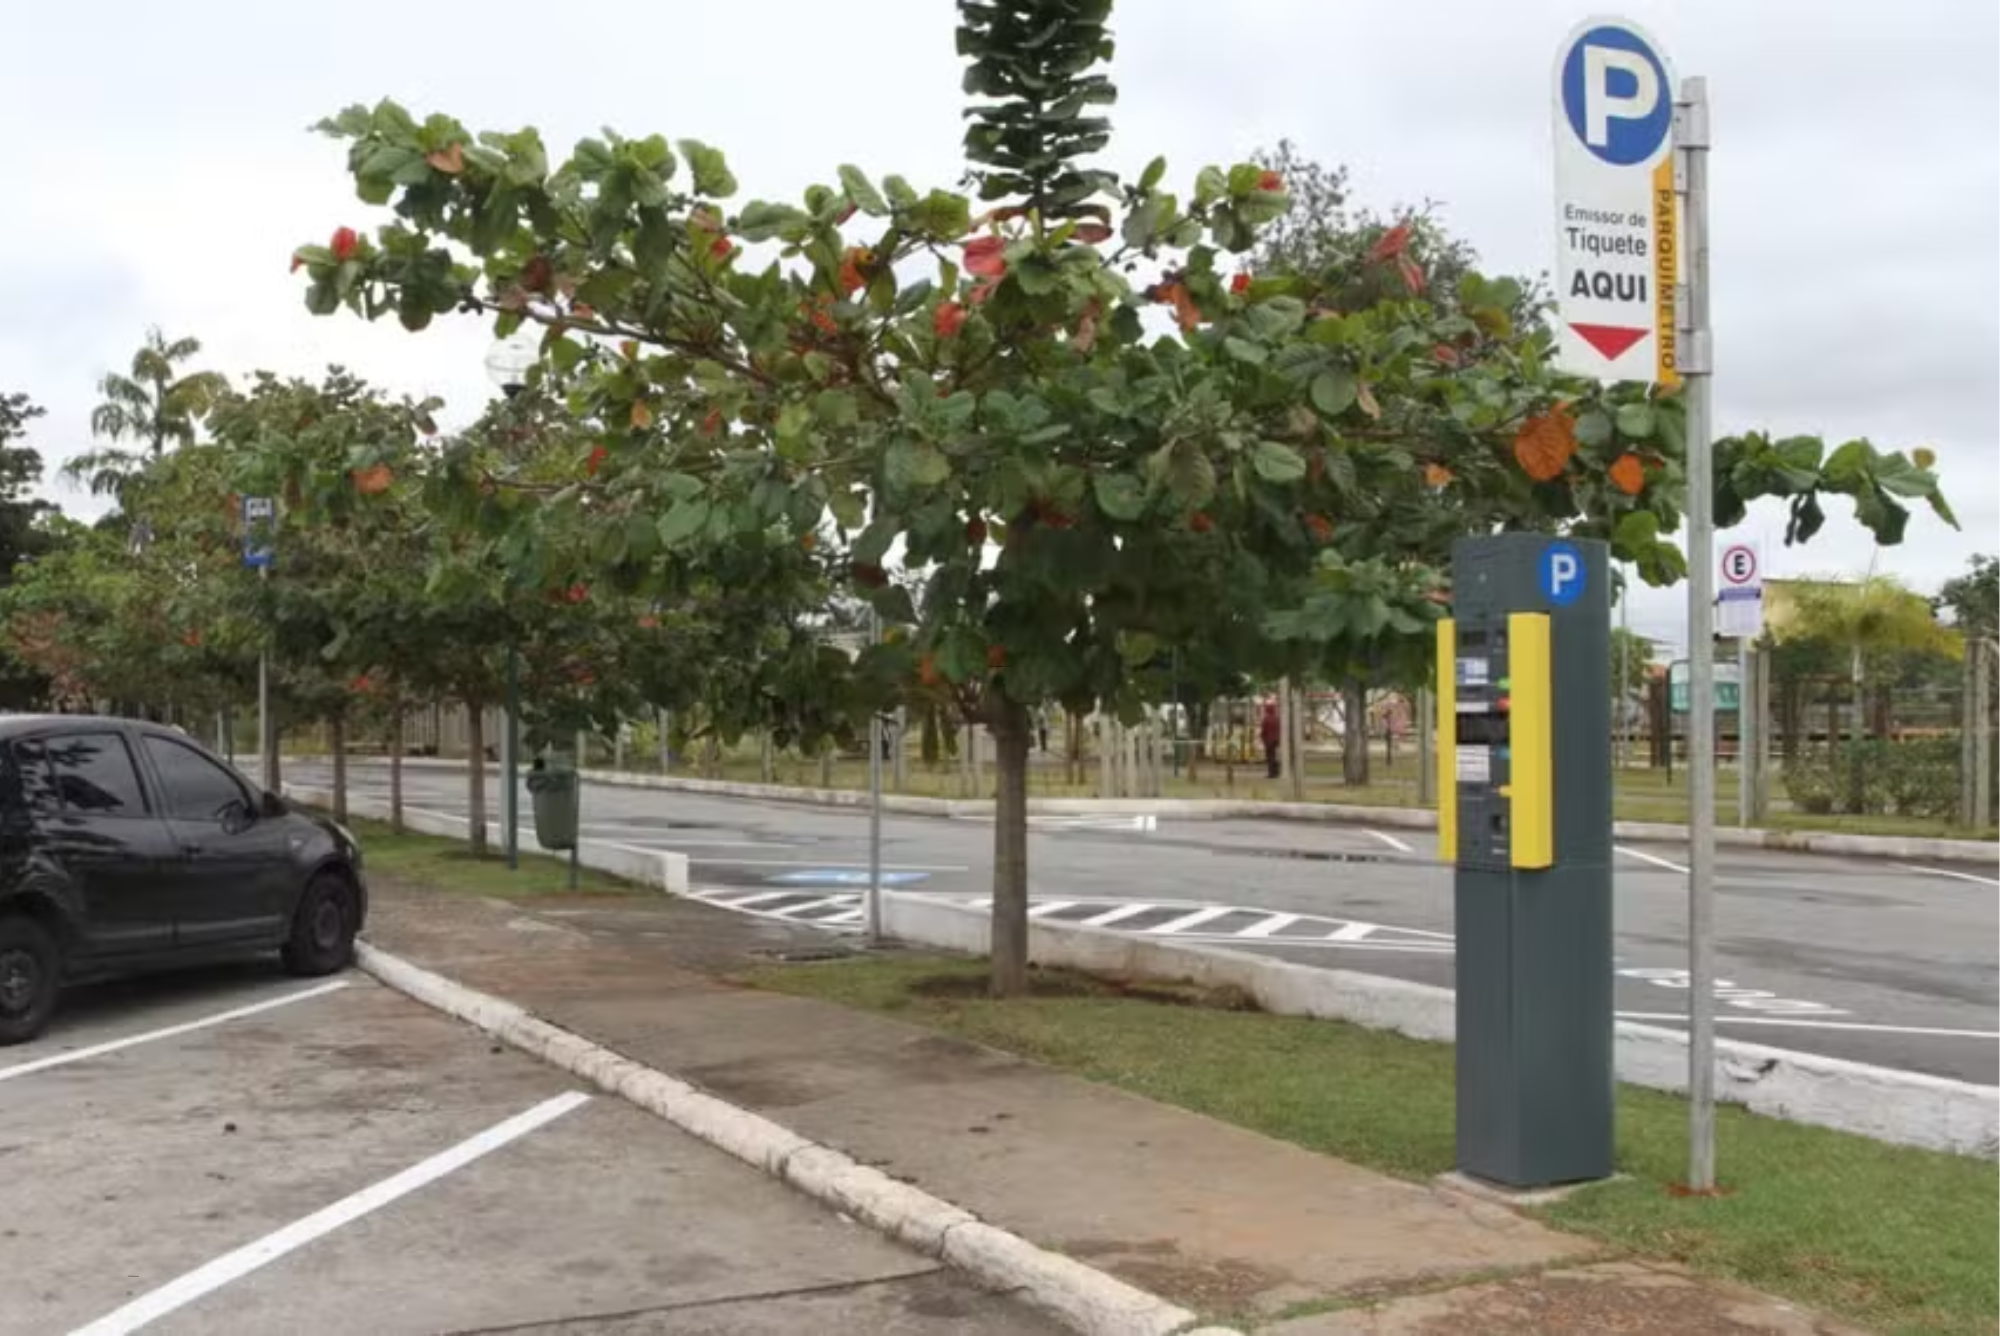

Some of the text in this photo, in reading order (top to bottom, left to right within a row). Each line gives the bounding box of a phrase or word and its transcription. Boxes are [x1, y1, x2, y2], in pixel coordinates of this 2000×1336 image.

[1584, 44, 1659, 147] P
[1564, 204, 1647, 229] Emissor de
[1565, 227, 1647, 258] Tiquete
[1570, 269, 1647, 303] AQUI
[1551, 554, 1577, 595] P
[1734, 554, 1745, 575] E
